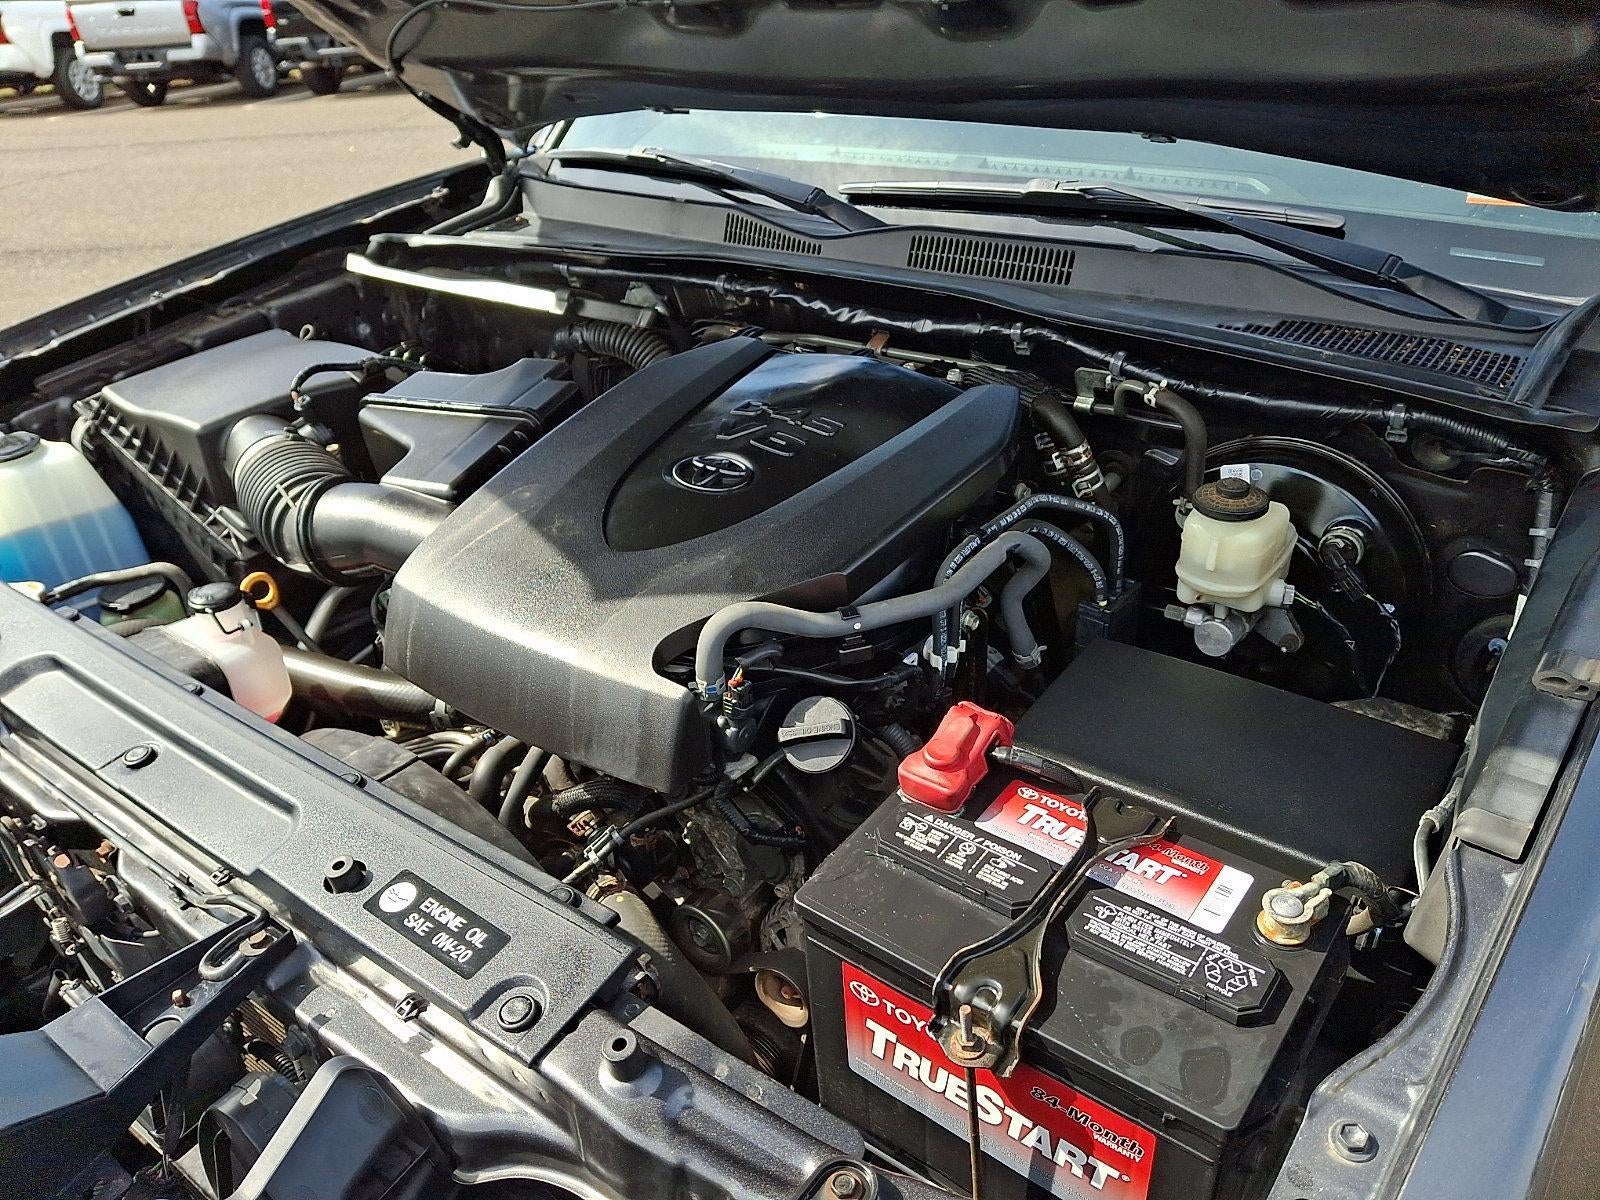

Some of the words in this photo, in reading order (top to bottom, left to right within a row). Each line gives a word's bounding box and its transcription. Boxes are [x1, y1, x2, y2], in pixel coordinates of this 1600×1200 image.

[934, 818, 976, 841] DANGER
[983, 839, 1022, 861] POISON
[403, 913, 434, 937] SAE
[431, 932, 473, 963] 0W-20
[419, 897, 467, 933] ENGINE
[464, 927, 488, 949] OIL
[1030, 1086, 1145, 1158] 84-Month
[1093, 1132, 1142, 1163] WARRANTY
